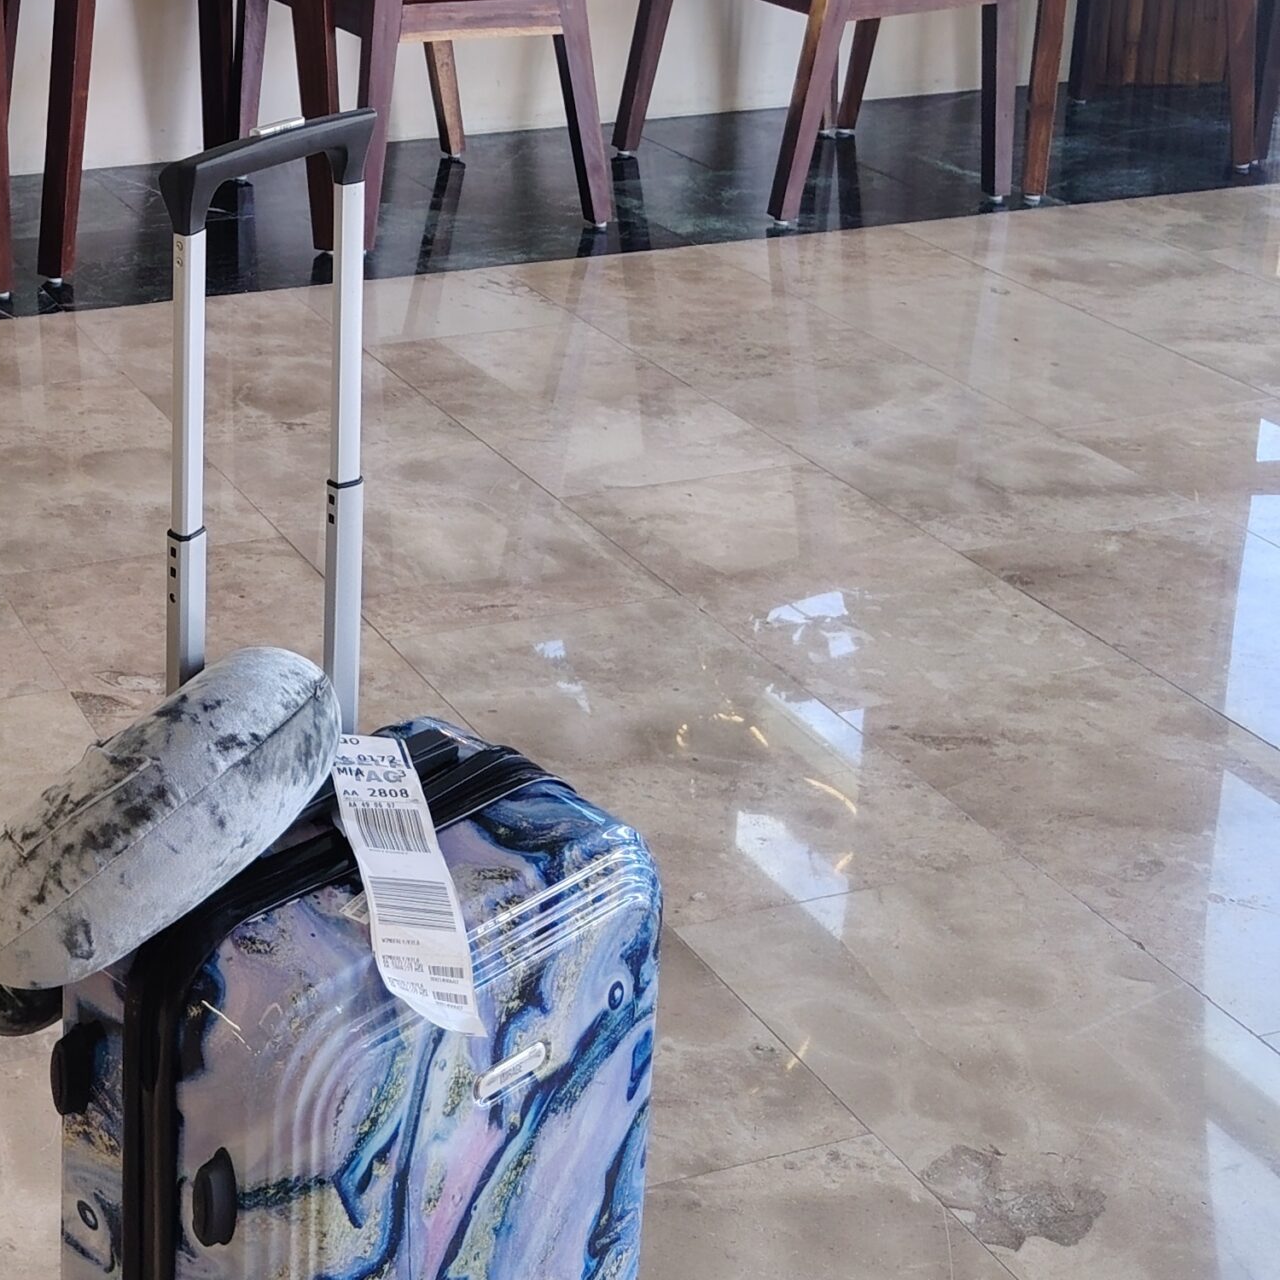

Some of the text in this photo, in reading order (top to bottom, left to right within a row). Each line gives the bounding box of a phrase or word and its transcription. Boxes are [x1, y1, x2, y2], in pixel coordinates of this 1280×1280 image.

[336, 766, 365, 777] MIA
[342, 788, 409, 798] AA 2808
